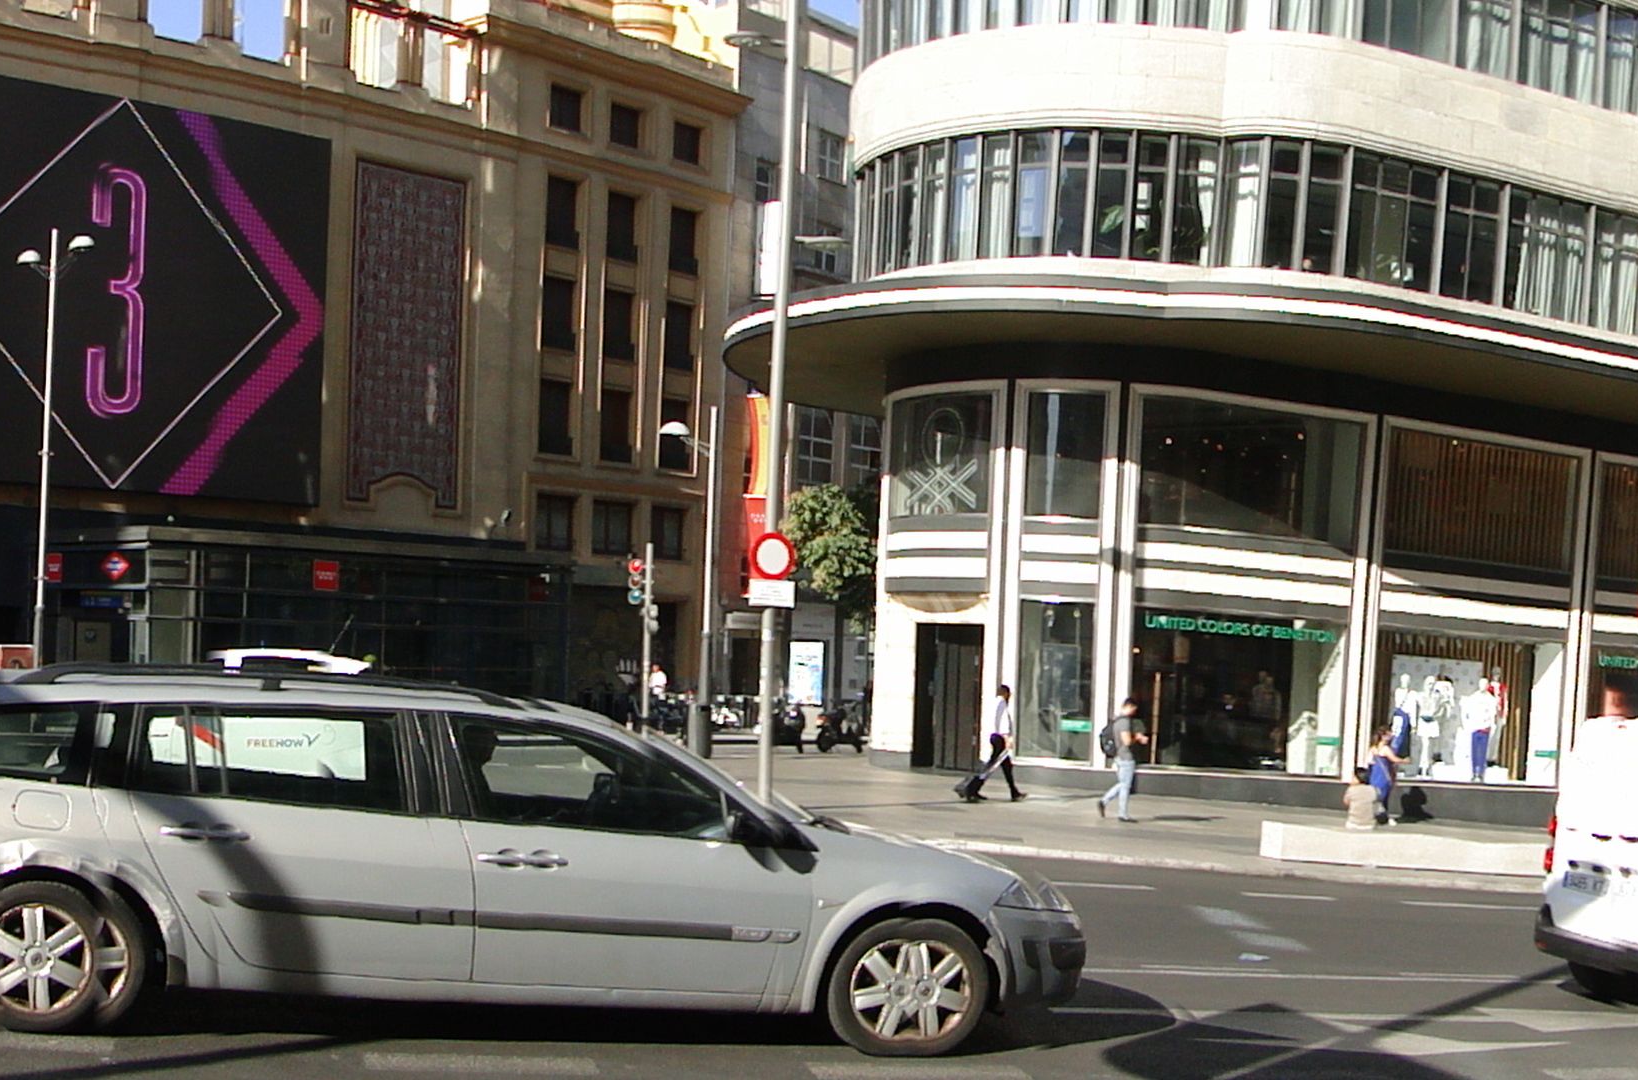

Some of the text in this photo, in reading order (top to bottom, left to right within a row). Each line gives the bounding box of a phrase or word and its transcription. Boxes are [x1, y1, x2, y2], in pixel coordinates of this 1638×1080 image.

[84, 162, 147, 417] 3
[1145, 613, 1337, 642] UNITED COLORS OF BENETTON
[1598, 653, 1637, 668] UNITED
